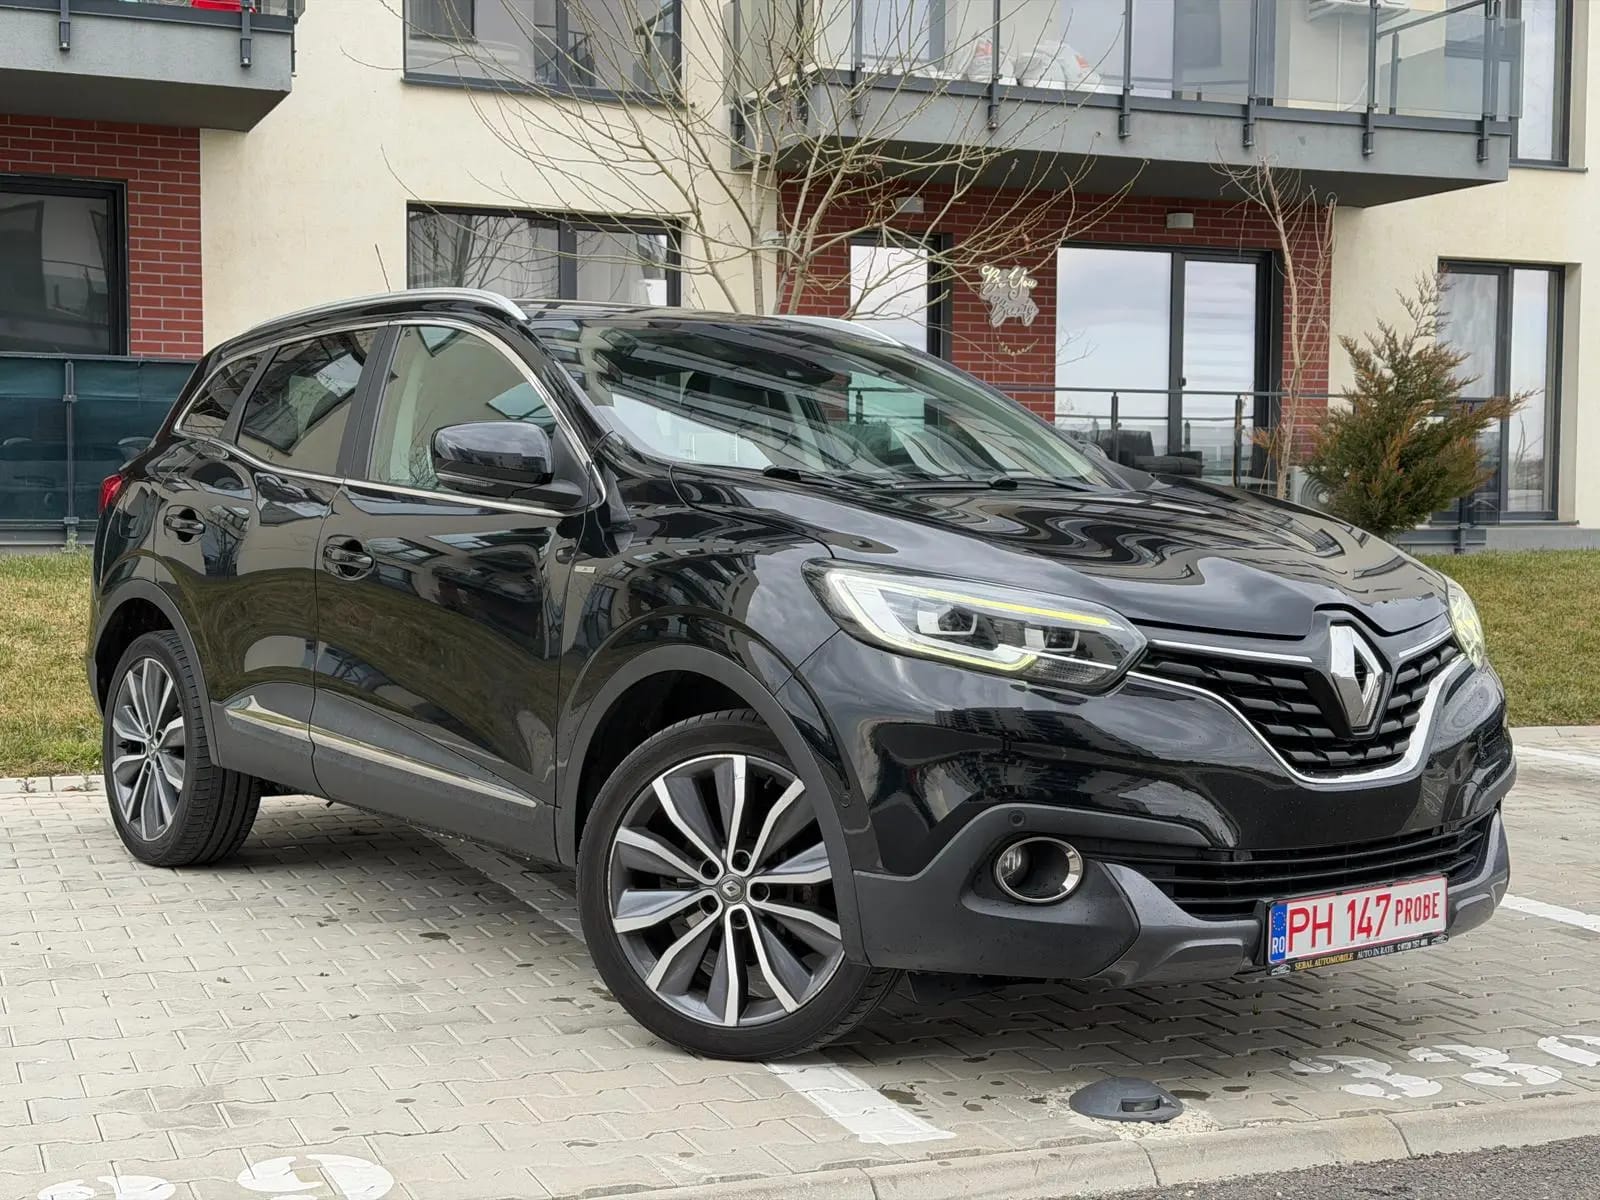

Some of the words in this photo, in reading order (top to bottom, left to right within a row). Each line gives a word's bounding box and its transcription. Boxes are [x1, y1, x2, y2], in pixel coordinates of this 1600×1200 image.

[1008, 266, 1038, 301] You
[1288, 902, 1334, 953] PH
[1346, 893, 1391, 942] 147
[1394, 891, 1440, 926] PROBE
[1272, 936, 1286, 955] RO
[1315, 953, 1354, 967] AUTOMOBILE
[1358, 948, 1372, 959] AUTO
